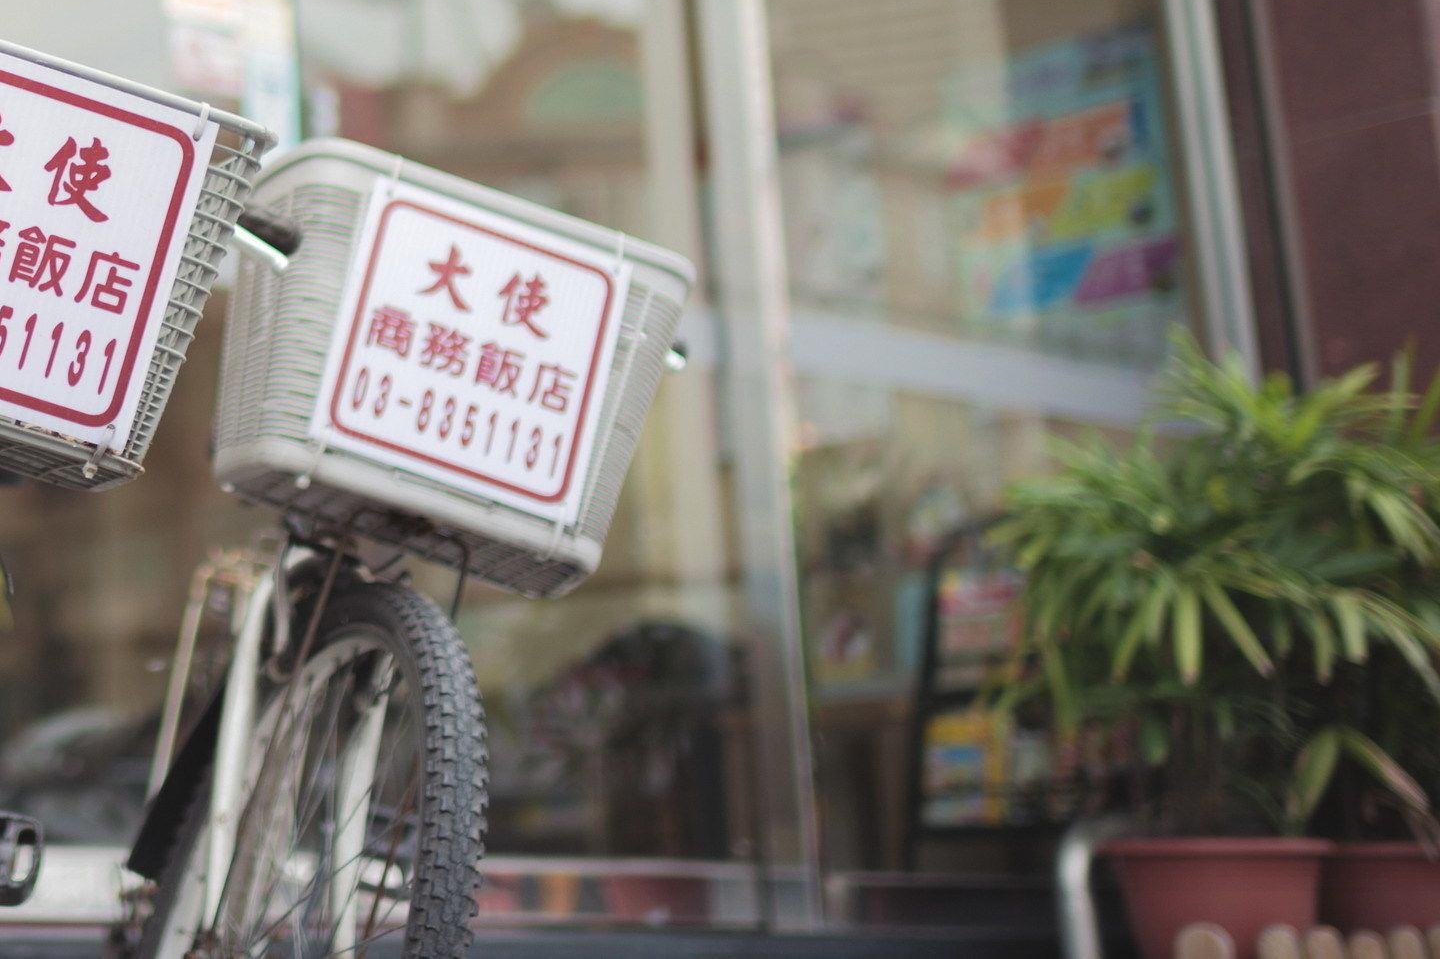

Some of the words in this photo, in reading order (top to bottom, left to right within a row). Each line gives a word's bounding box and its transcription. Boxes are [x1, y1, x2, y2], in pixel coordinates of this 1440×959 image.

[417, 244, 550, 339] 大使
[366, 305, 578, 415] 商務飯店
[352, 367, 564, 479] 03-8351131
